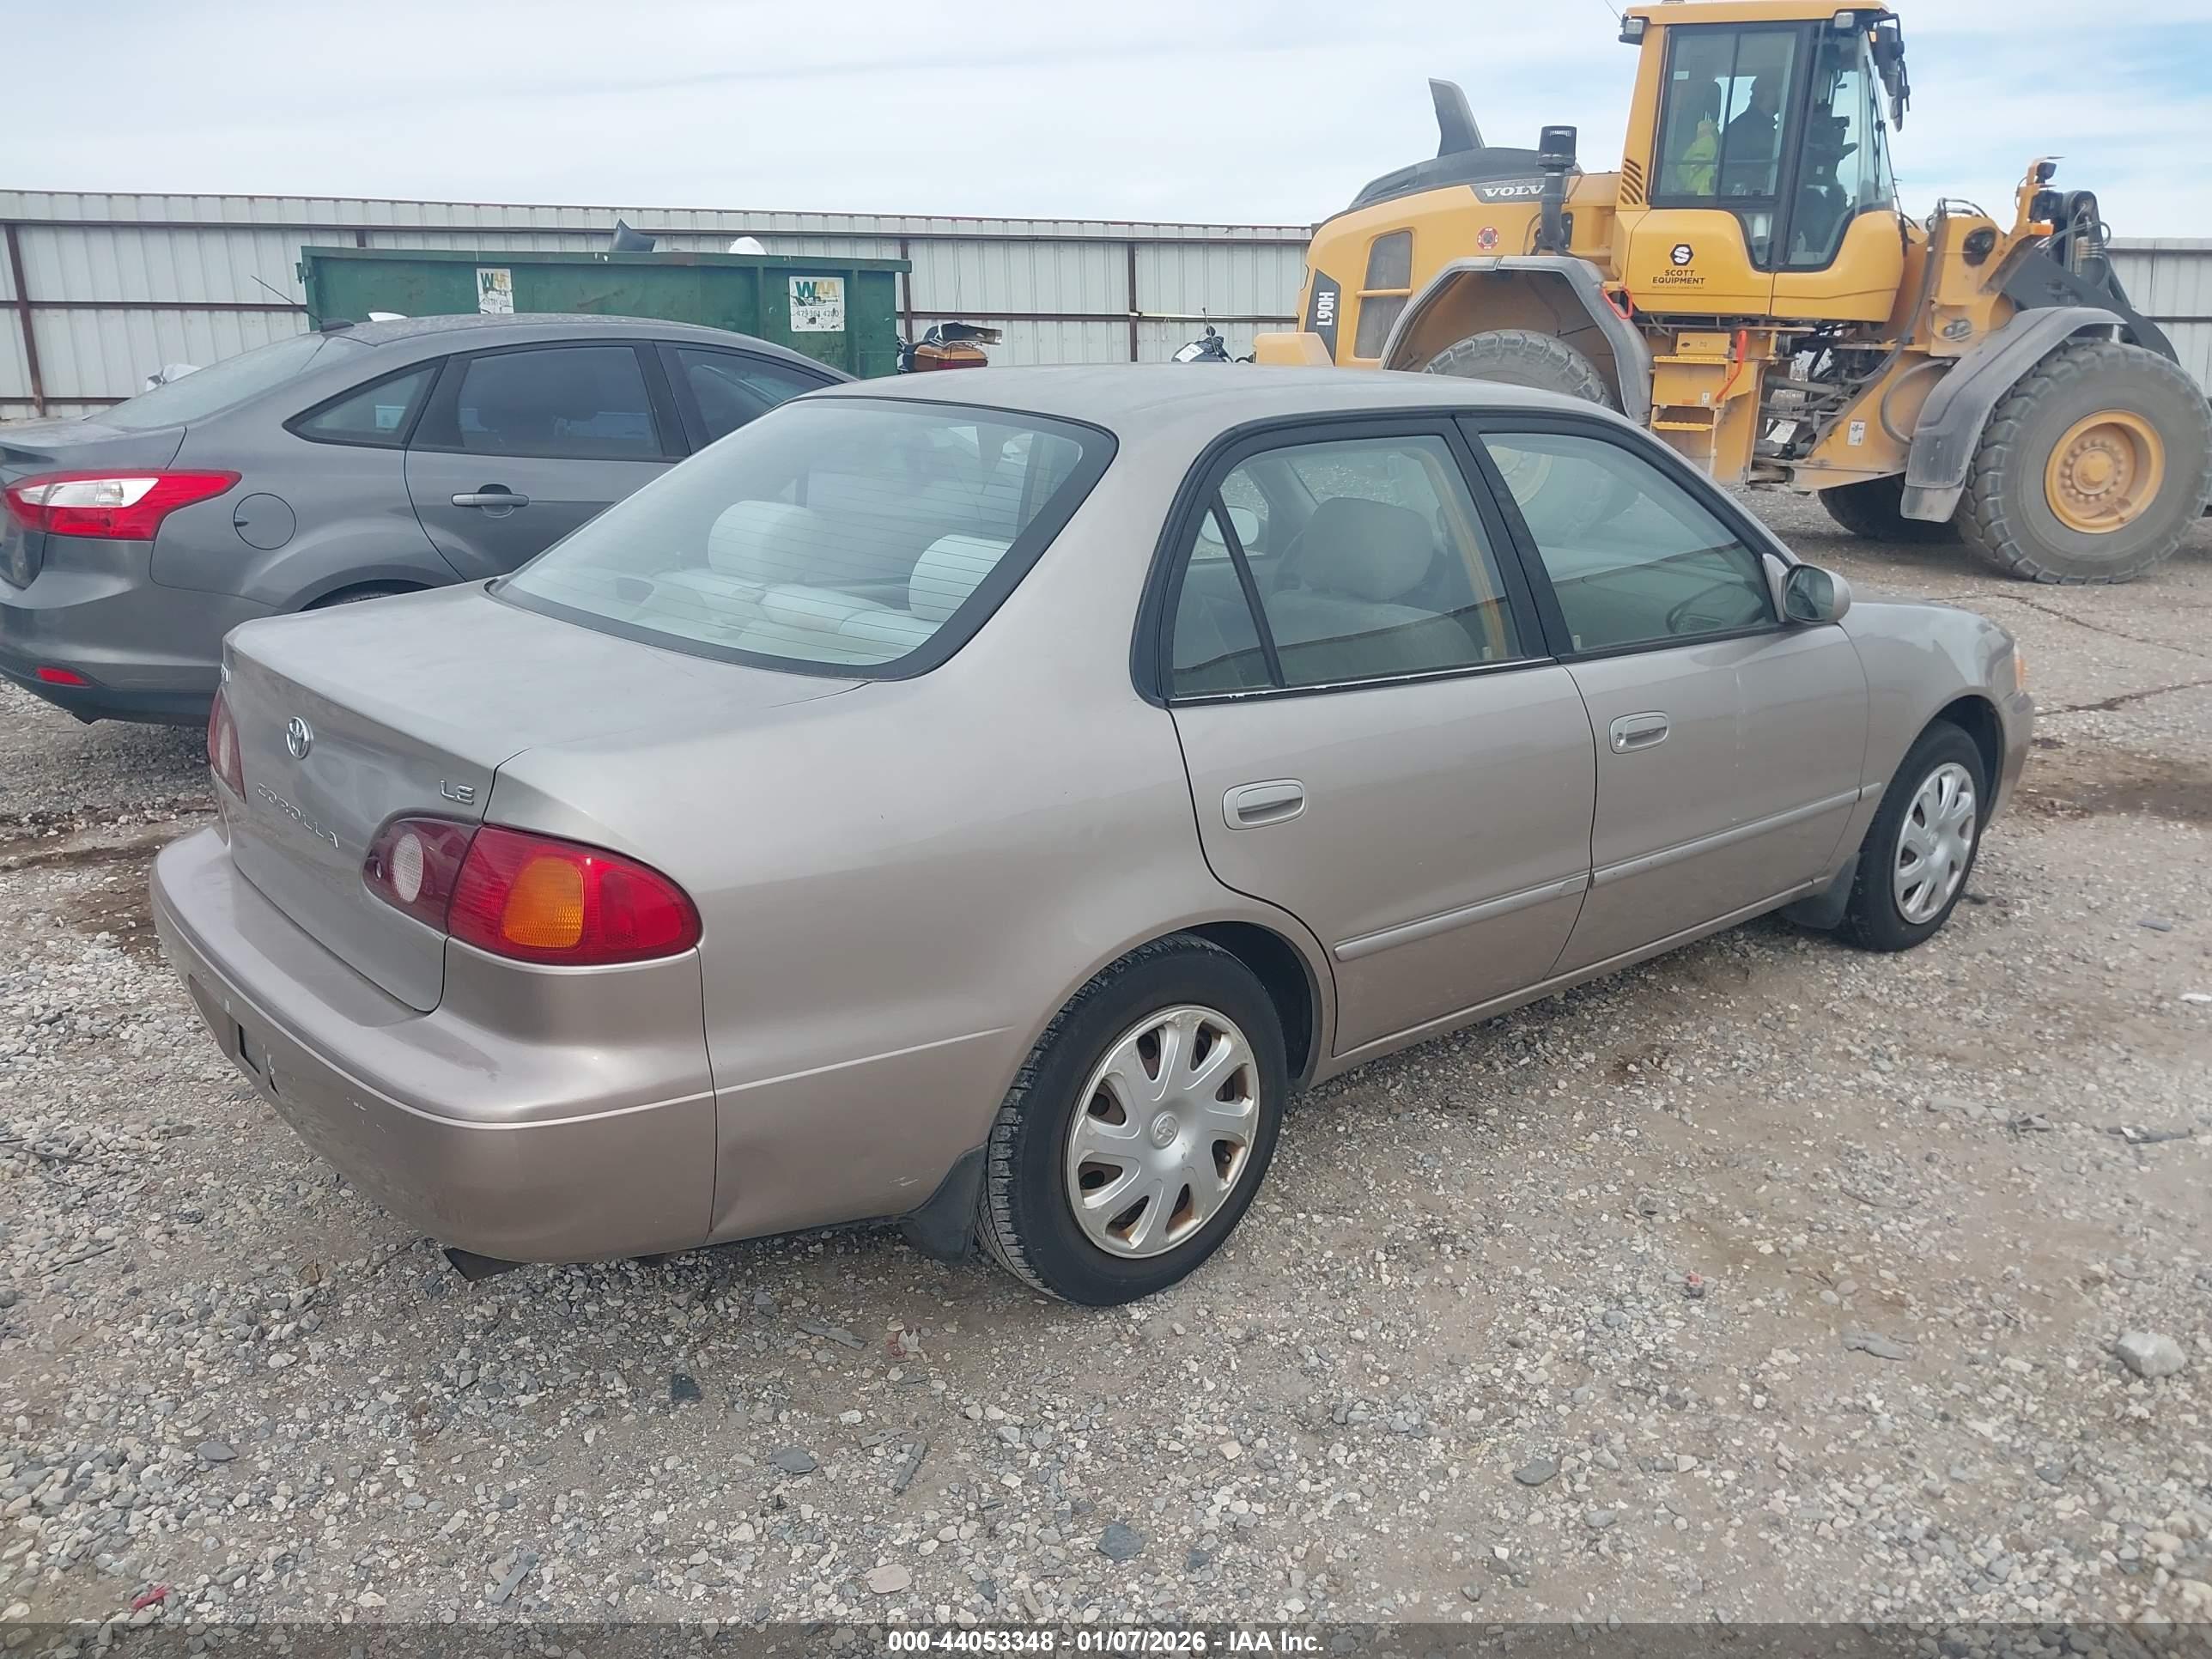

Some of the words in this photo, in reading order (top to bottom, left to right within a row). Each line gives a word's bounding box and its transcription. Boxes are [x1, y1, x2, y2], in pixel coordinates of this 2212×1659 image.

[1482, 185, 1546, 198] VOLV
[795, 281, 838, 297] WM
[1316, 292, 1334, 325] L90H
[440, 780, 474, 805] LE
[258, 782, 339, 849] COROLLA
